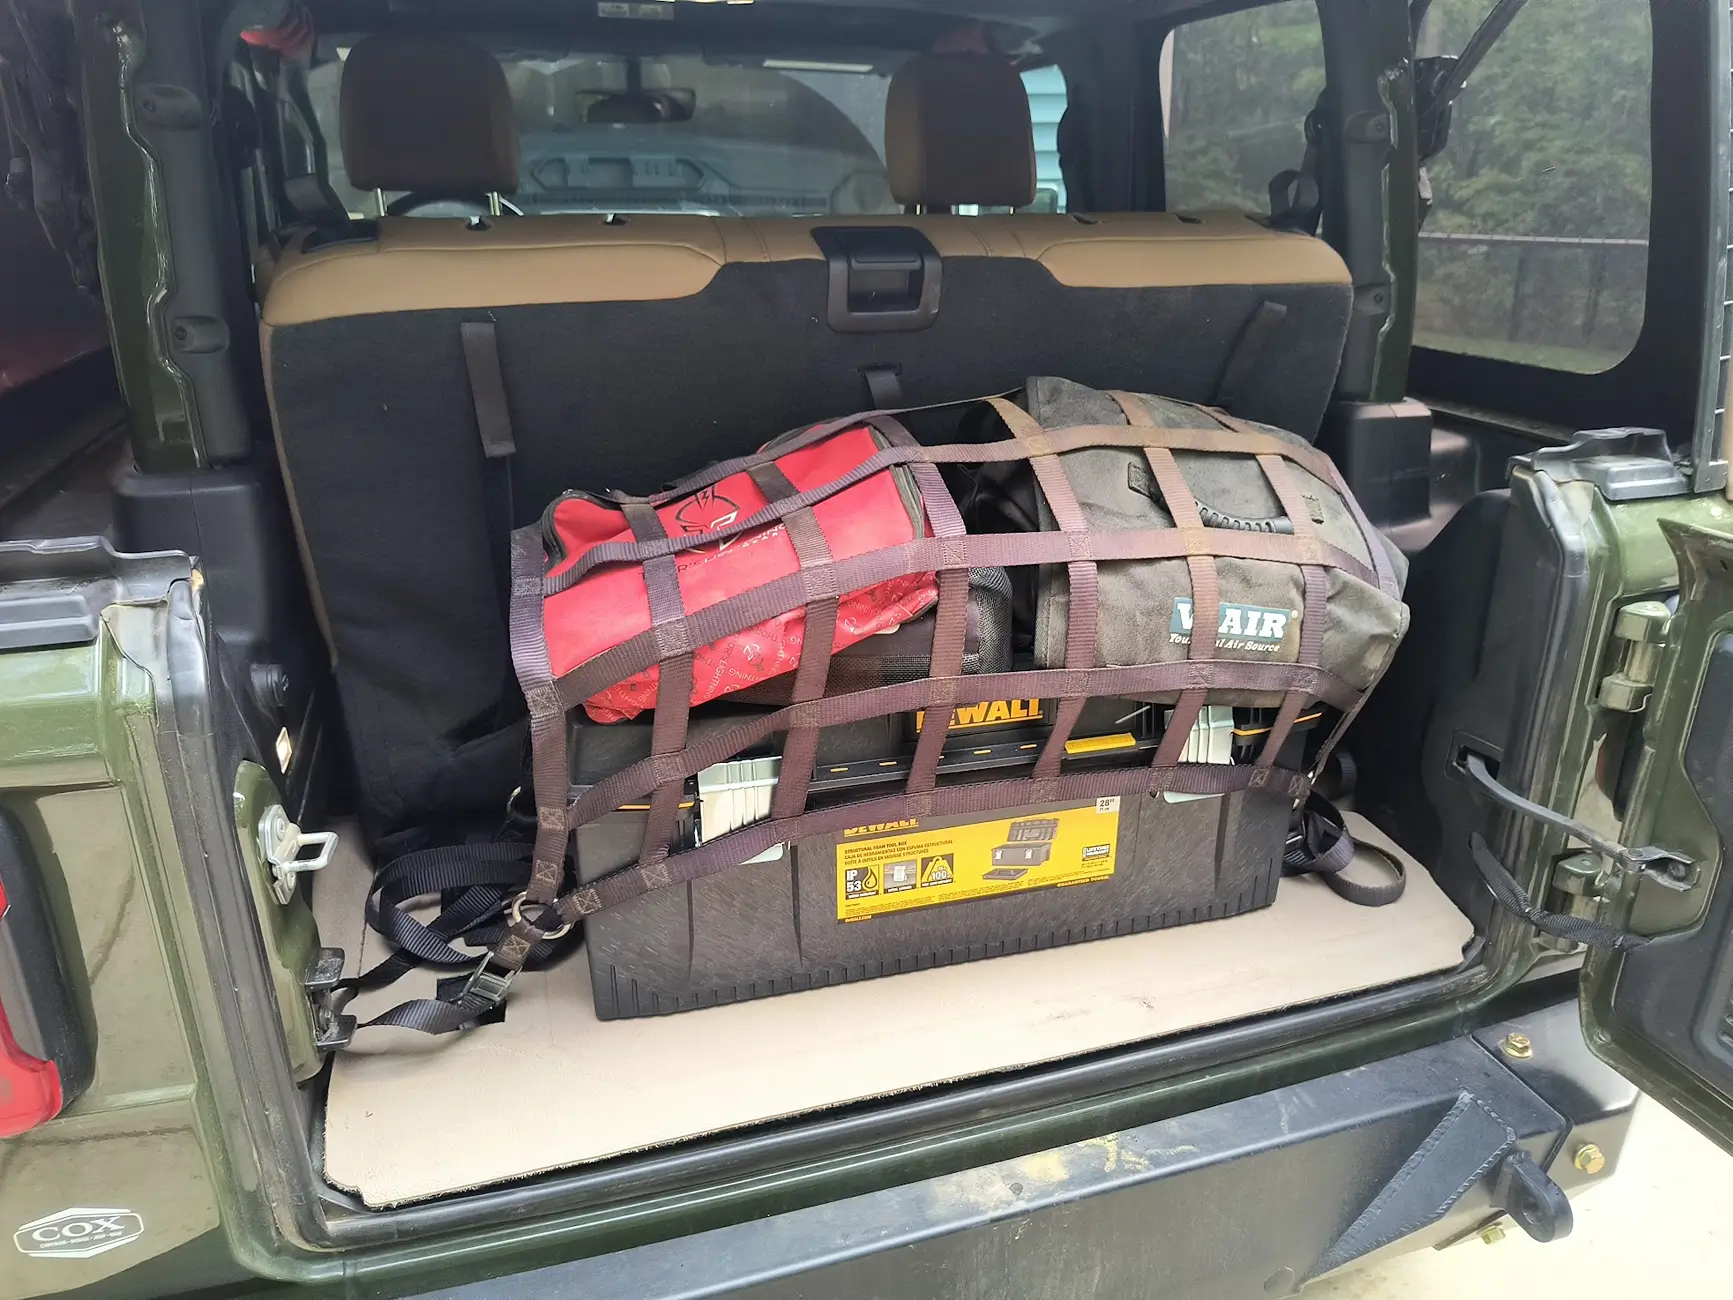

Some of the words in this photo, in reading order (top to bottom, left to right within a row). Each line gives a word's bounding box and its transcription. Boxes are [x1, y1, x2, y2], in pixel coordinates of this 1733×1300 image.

[1177, 603, 1287, 638] VAIR
[1224, 641, 1245, 650] Air
[1244, 641, 1280, 652] Source
[845, 846, 872, 854] STRUCTURAL
[863, 848, 895, 857] HERRAMIENTAS
[925, 839, 953, 848] ESTRUCTURAL
[846, 869, 858, 880] IP
[931, 871, 947, 880] 100
[846, 880, 862, 892] 53
[32, 1216, 125, 1241] COX
